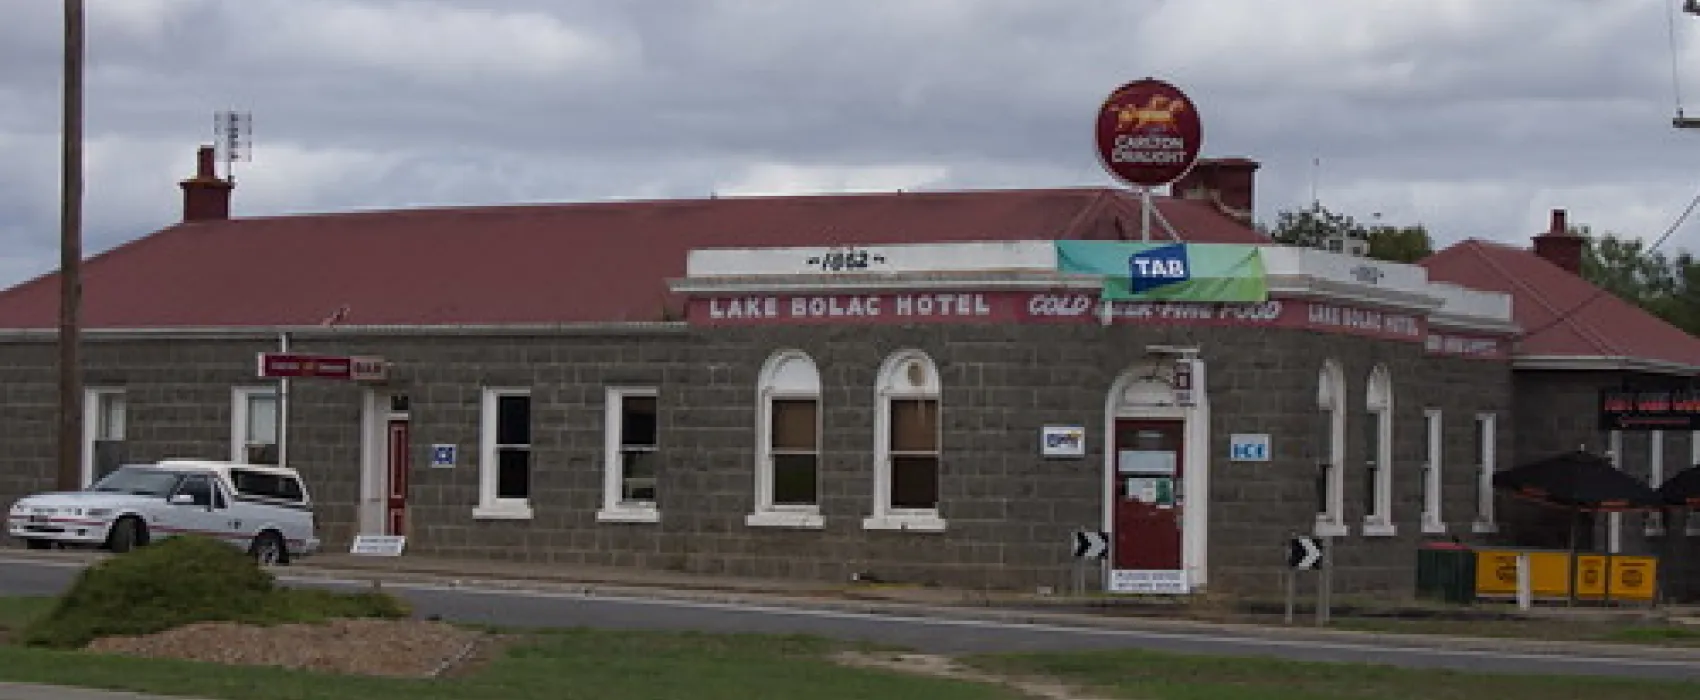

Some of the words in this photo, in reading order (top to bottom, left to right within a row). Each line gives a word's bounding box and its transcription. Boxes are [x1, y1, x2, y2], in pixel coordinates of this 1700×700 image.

[1114, 135, 1184, 149] CARLTON
[1112, 149, 1187, 163] DRAUGHT
[1134, 259, 1185, 279] TAB
[709, 297, 779, 319] LAKE
[791, 296, 881, 316] BOLAC
[896, 293, 990, 316] HOTEL
[1028, 294, 1092, 316] COLD
[1233, 443, 1267, 459] ICE
